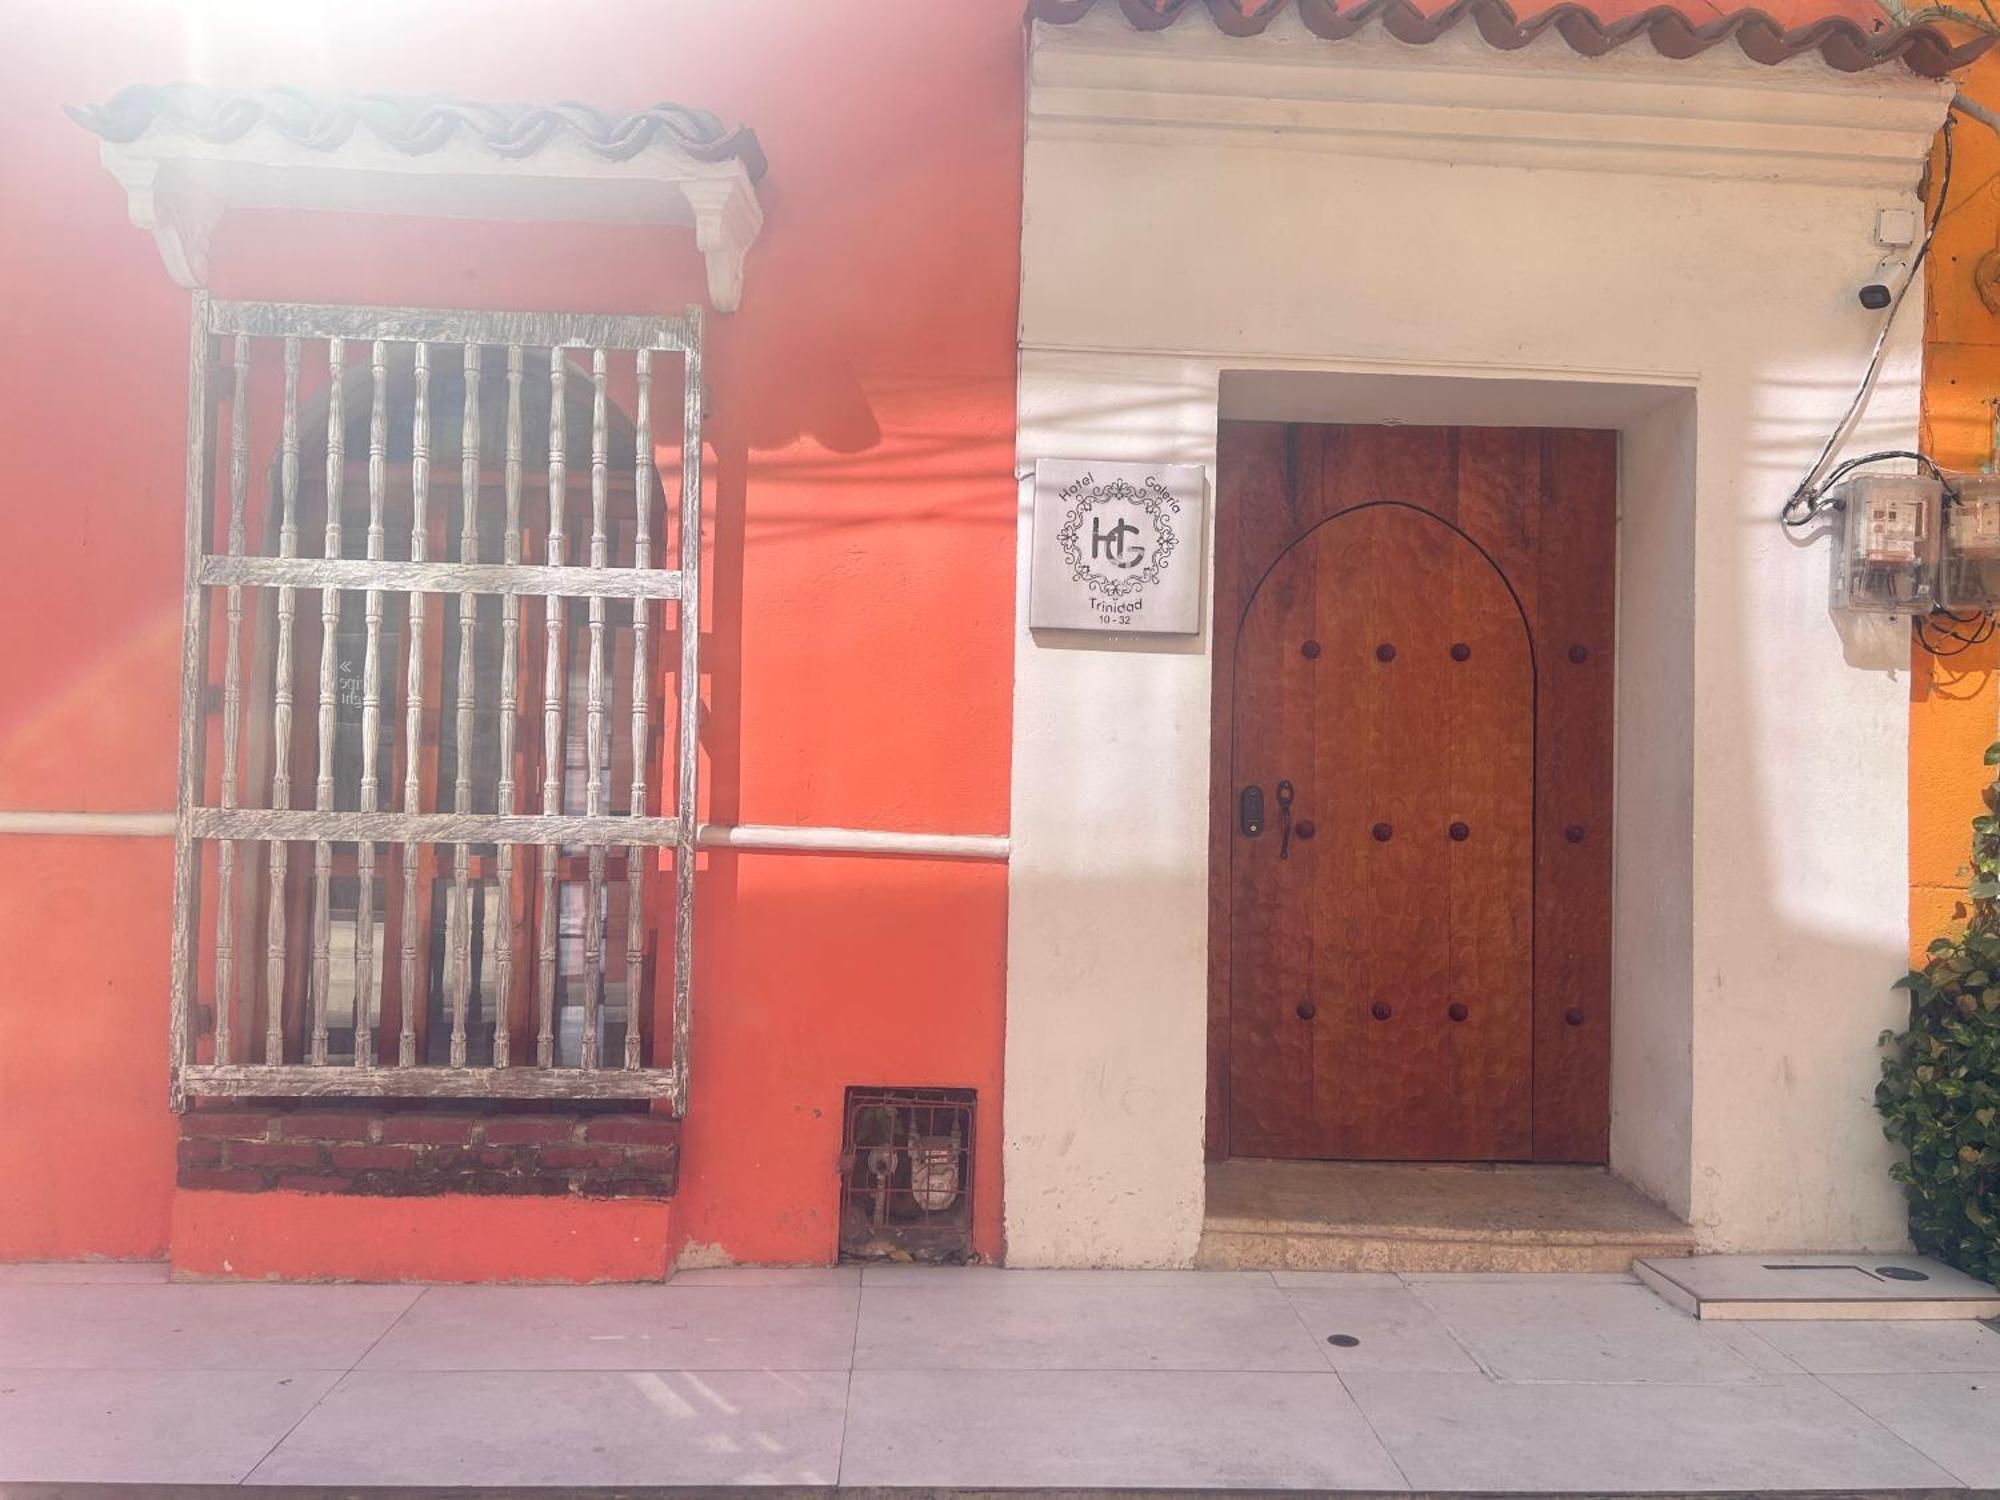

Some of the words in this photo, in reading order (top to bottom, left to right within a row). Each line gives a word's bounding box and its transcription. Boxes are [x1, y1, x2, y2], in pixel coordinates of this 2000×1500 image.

[1058, 472, 1095, 502] Hotel
[1092, 516, 1145, 568] HG
[1089, 598, 1142, 613] Trinidad
[1099, 615, 1110, 624] 10
[1119, 615, 1131, 624] 32
